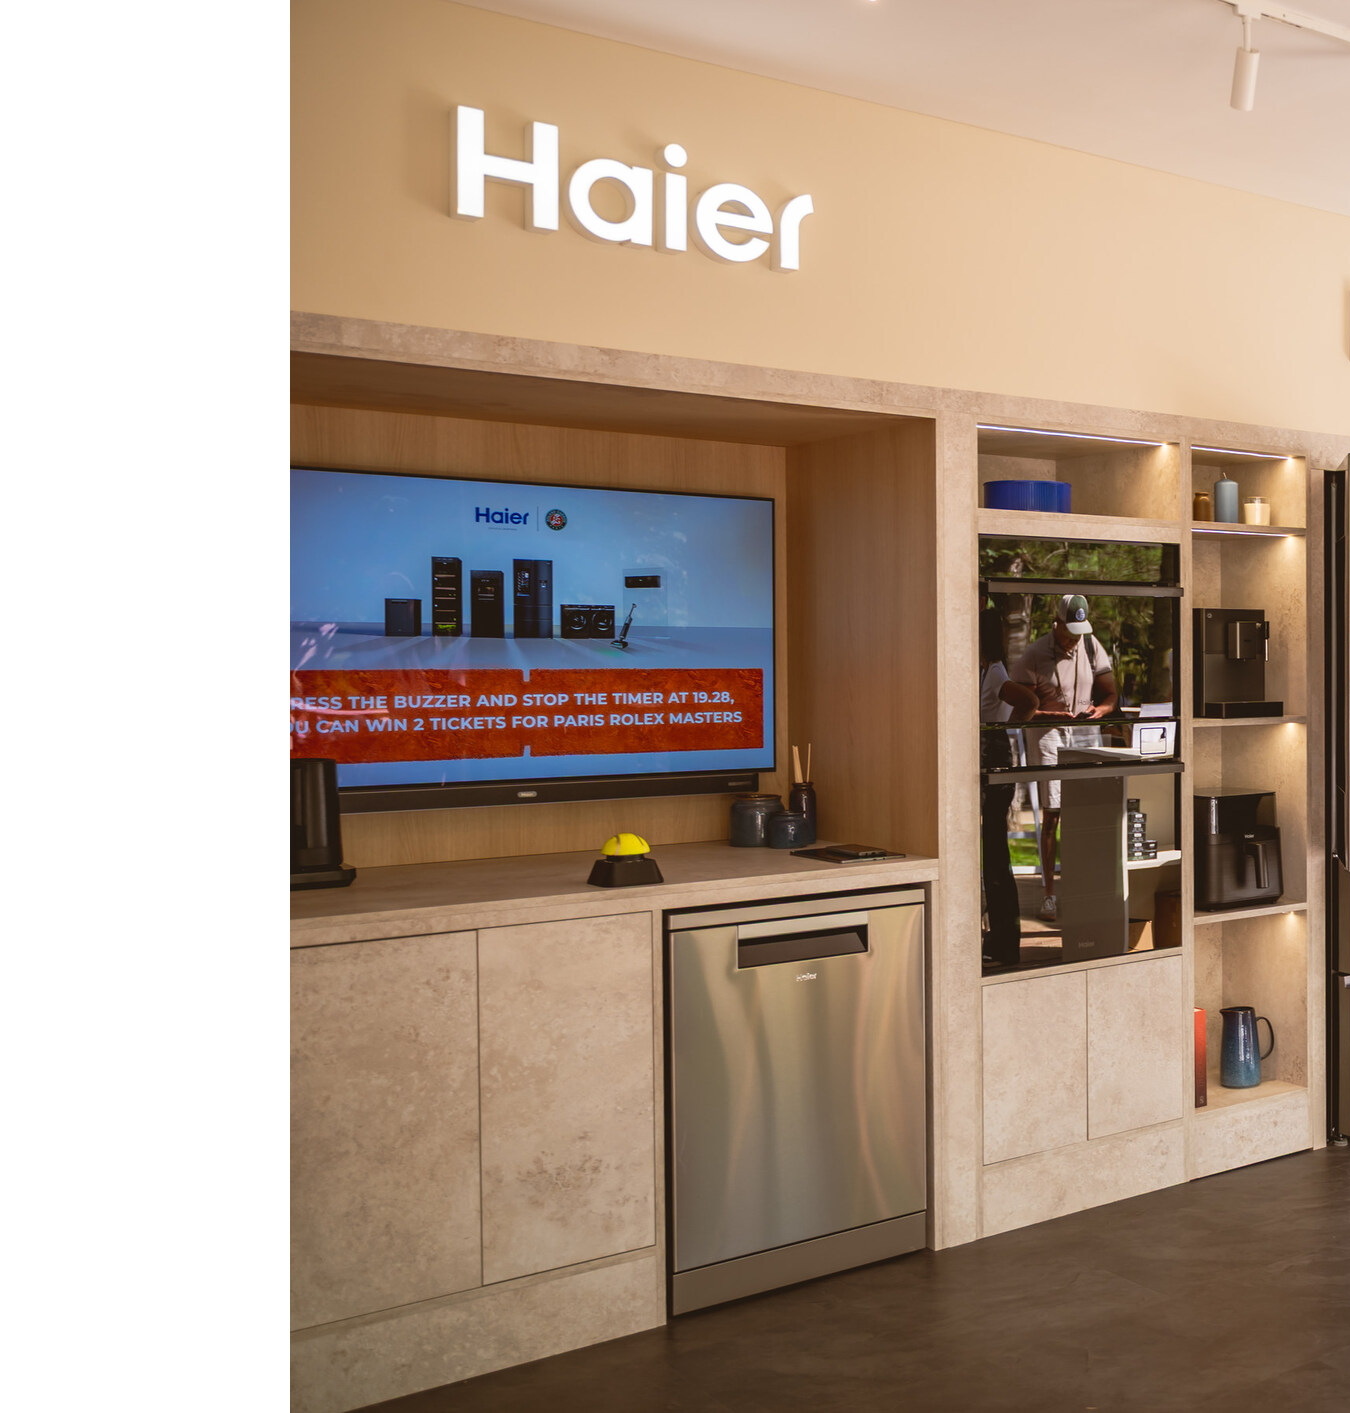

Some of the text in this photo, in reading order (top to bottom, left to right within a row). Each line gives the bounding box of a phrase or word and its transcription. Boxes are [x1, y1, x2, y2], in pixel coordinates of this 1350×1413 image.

[455, 105, 814, 271] Haier
[475, 507, 529, 525] Haier
[347, 696, 388, 709] THE
[394, 695, 471, 709] BUZZER
[476, 694, 518, 707] AND
[522, 693, 569, 706] STOP
[573, 693, 608, 705] THE
[612, 692, 664, 705] TIMER
[668, 692, 690, 704] AT
[693, 691, 735, 705] 19.28,
[315, 720, 359, 733] CAN
[366, 718, 408, 732] WIN
[413, 718, 425, 731] 2
[429, 716, 507, 730] TICKETS
[512, 715, 549, 729] FOR
[554, 714, 605, 727] PARIS
[609, 713, 665, 726] ROLEX
[669, 711, 743, 725] MASTERS
